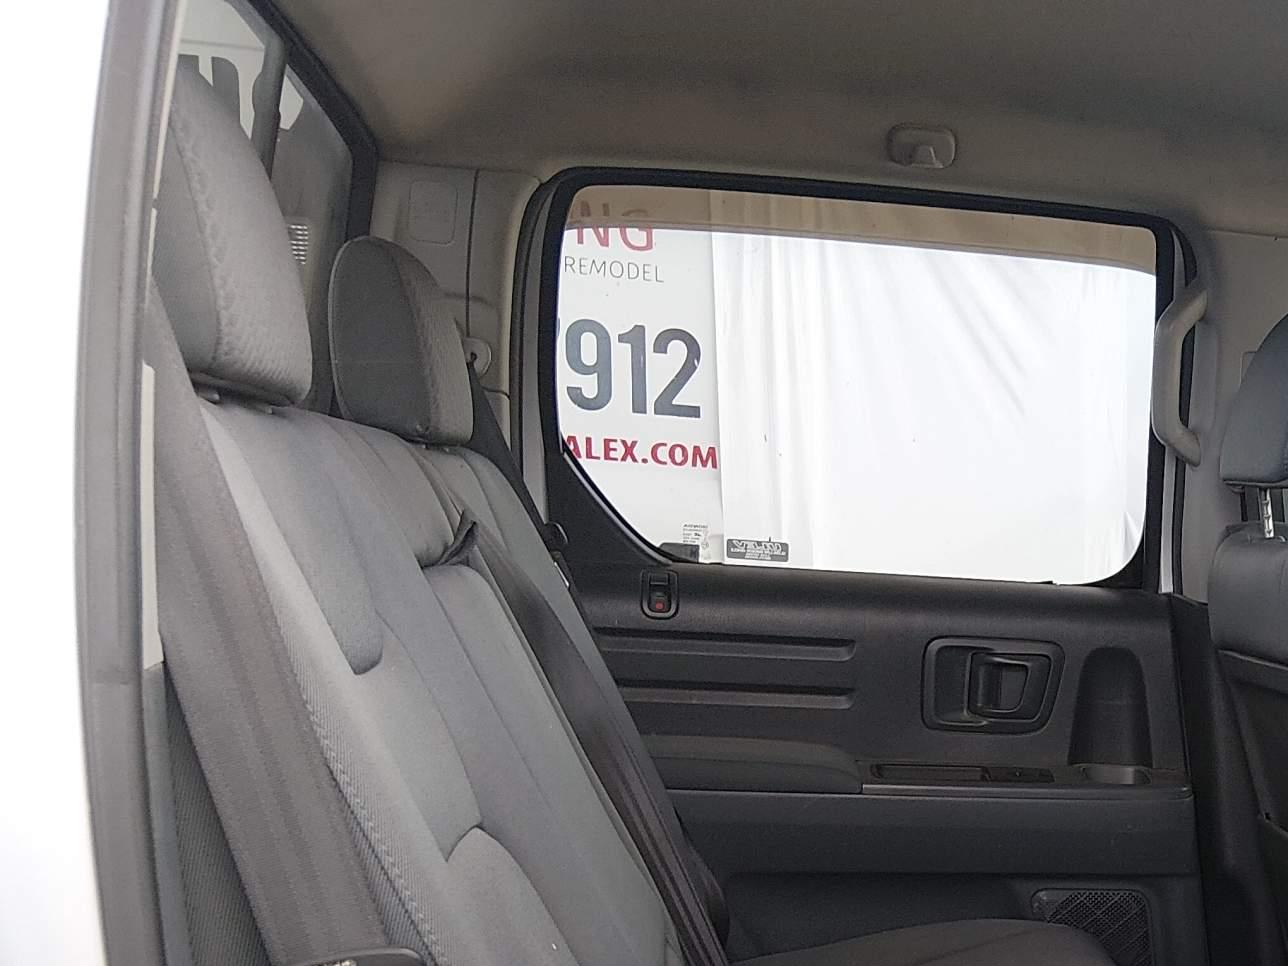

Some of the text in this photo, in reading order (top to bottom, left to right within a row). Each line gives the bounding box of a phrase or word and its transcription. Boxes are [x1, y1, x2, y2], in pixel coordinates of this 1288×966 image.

[564, 255, 665, 283] REMODEL
[556, 318, 702, 419] 912
[566, 435, 718, 470] ALEX.COM
